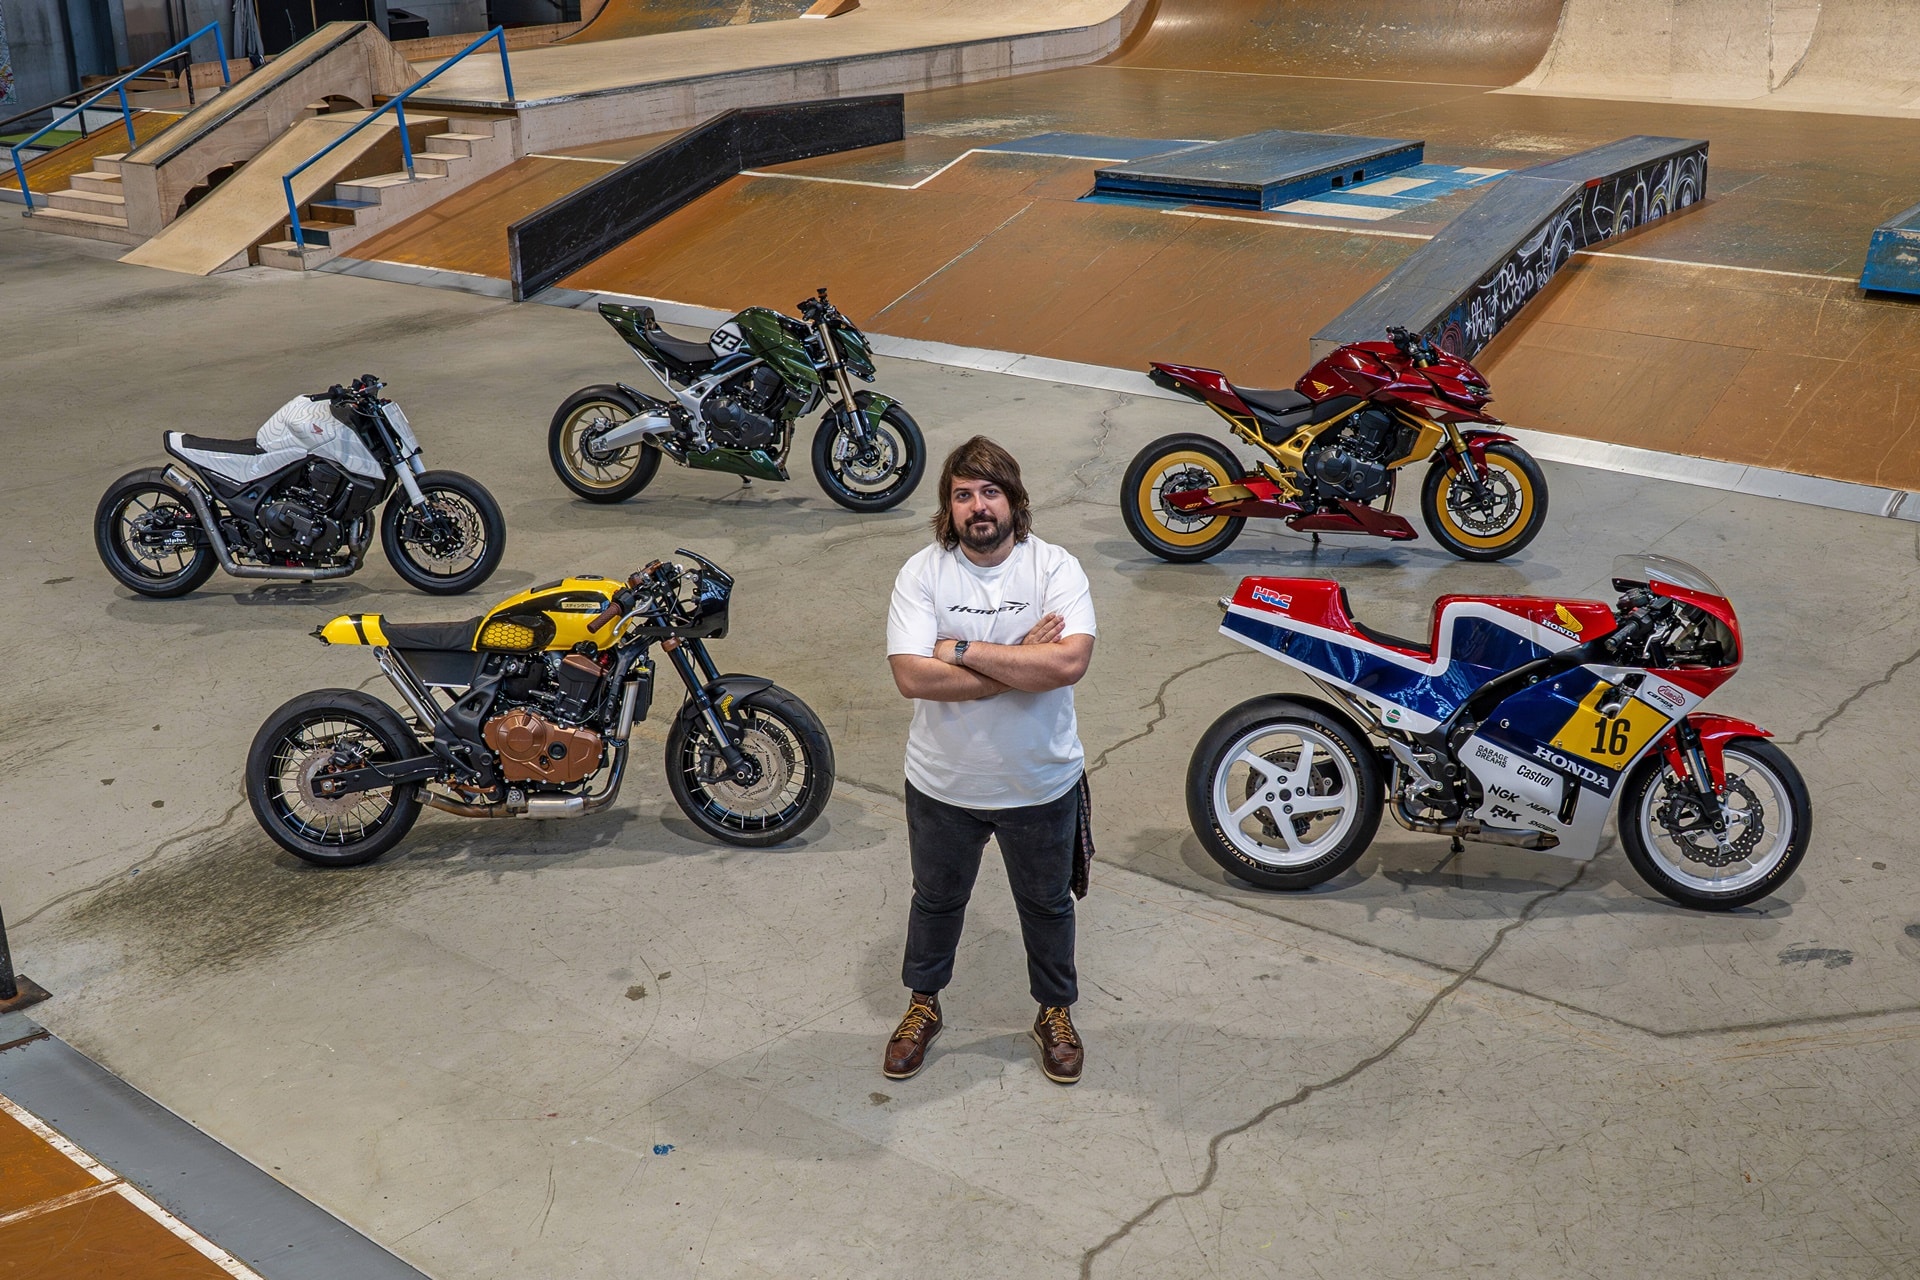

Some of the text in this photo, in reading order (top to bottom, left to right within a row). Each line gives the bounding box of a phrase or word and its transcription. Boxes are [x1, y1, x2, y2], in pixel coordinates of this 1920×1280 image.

[711, 329, 743, 352] 93
[1252, 585, 1292, 609] HRC
[1541, 619, 1581, 641] HONDA
[1323, 729, 1357, 763] MICHELIN
[1590, 716, 1631, 756] 16
[1475, 751, 1507, 769] DREAMS
[1478, 745, 1508, 761] GARAGE
[1516, 765, 1554, 787] Castrol
[1533, 745, 1610, 789] HONDA
[1488, 784, 1520, 803] NGK
[1489, 804, 1522, 822] RK
[1215, 827, 1248, 862] MICHELIN
[1767, 851, 1791, 880] MICHELIN
